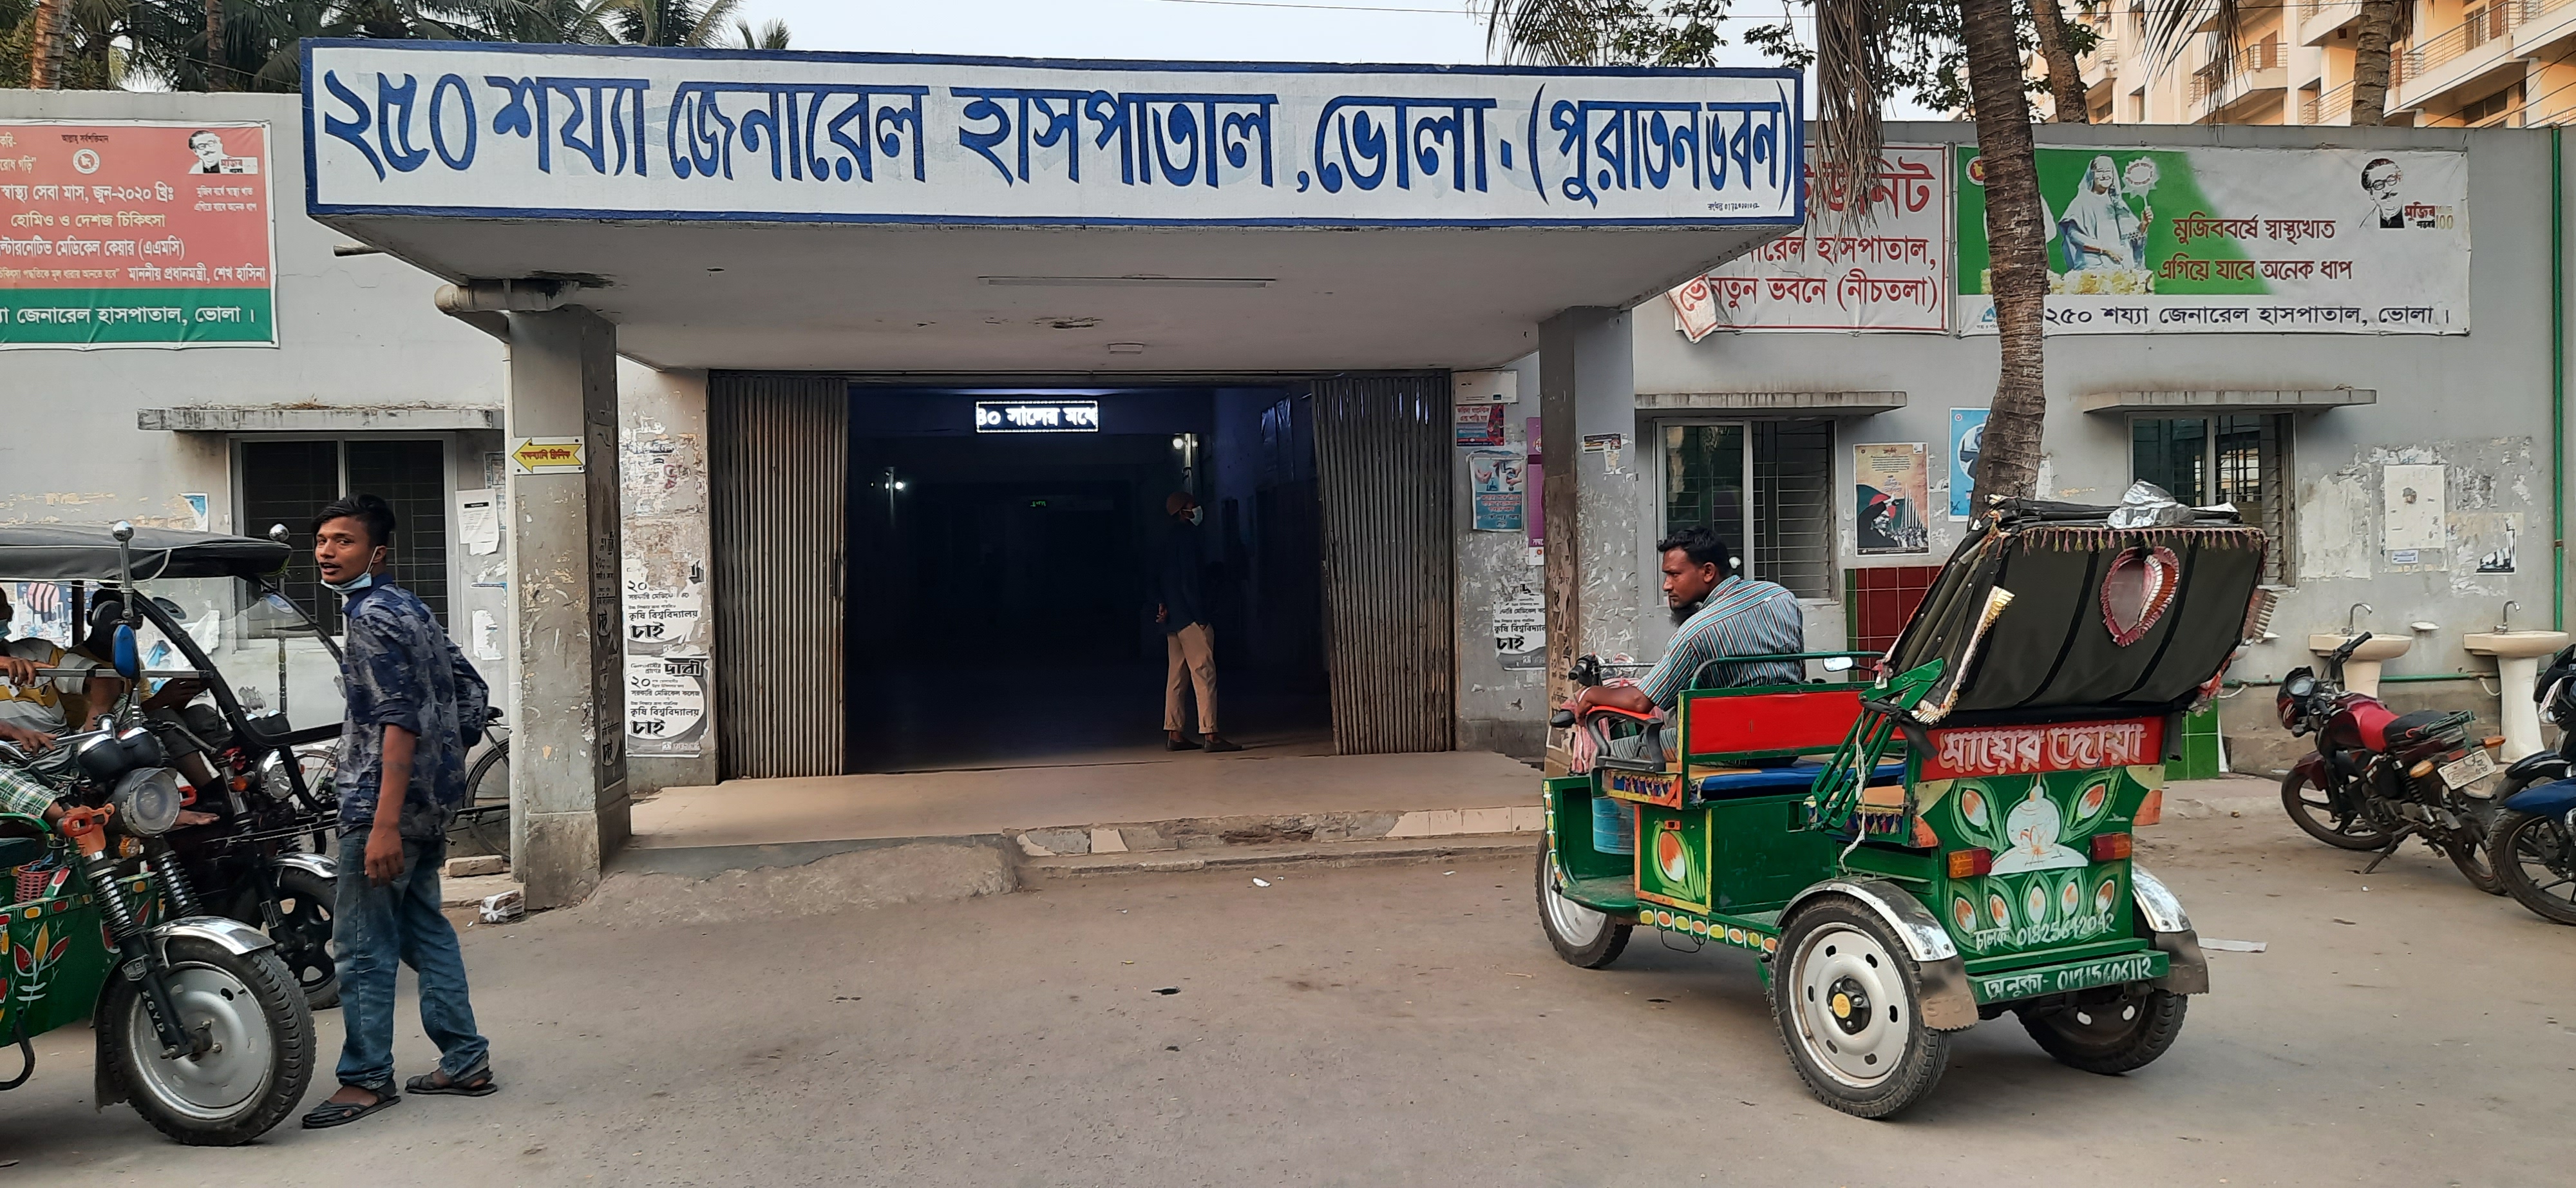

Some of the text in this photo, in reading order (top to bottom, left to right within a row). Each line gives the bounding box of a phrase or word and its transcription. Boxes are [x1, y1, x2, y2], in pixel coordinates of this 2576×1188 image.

[325, 71, 477, 182] ২৫০
[484, 75, 650, 176] শয্যা
[668, 82, 929, 182] জেনারেল
[949, 86, 1278, 188] হাসপাতাল
[33, 184, 59, 201] সেবা
[62, 184, 89, 204] মাস,
[11, 211, 166, 228] হোমিও ও দেশজ চিকিৎসা
[2173, 211, 2336, 245] মুজিববর্ষে স্বাস্থ্যখাত
[56, 235, 102, 256] মেডিকেল
[104, 239, 135, 256] কেয়ার
[138, 235, 185, 261] (এএমসি)
[128, 262, 161, 282] মাননীয়
[164, 262, 211, 284] প্রধানমন্ত্রী,
[214, 266, 233, 282] শেখ
[234, 263, 266, 283] হাসিনা
[2158, 252, 2353, 281] এগিয়ে যাবে অনেক ধাপ
[1765, 278, 1828, 305] ভবনে
[1837, 268, 1937, 313] (নীচতলা)
[17, 307, 91, 324] জেনারেল
[95, 306, 188, 326] হাসপাতাল,
[195, 306, 242, 323] ভোলা
[2045, 308, 2092, 325] ২৫০
[2100, 306, 2149, 325] শয্যা
[2159, 306, 2249, 324] জেনারেল
[2256, 306, 2367, 327] হাসপাতাল,
[2379, 306, 2434, 323] ভোলা
[1005, 406, 1060, 426] সালের
[629, 609, 698, 621] কৃষি বিশ্ববিদ্যালয়
[630, 676, 650, 689] ২০
[630, 706, 699, 717] কৃষি বিশ্ববিদ্যালয়
[1938, 724, 2147, 774] মায়ের দোয়া
